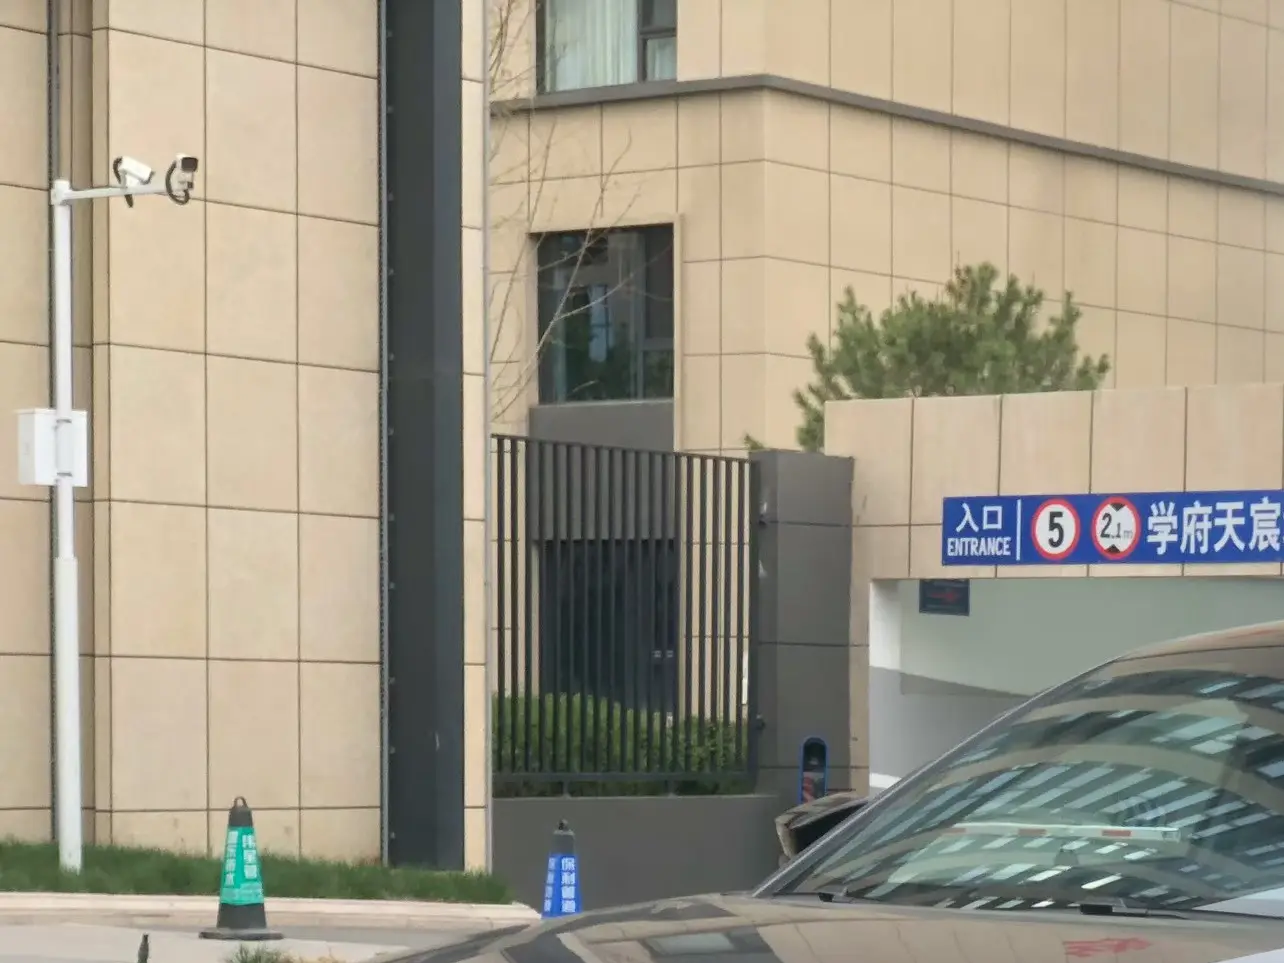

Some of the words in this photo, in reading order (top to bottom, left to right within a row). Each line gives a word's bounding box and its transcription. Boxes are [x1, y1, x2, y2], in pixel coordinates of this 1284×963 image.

[955, 502, 1003, 533] 入口
[1048, 511, 1065, 548] 5
[947, 537, 1012, 557] ENTRANCE
